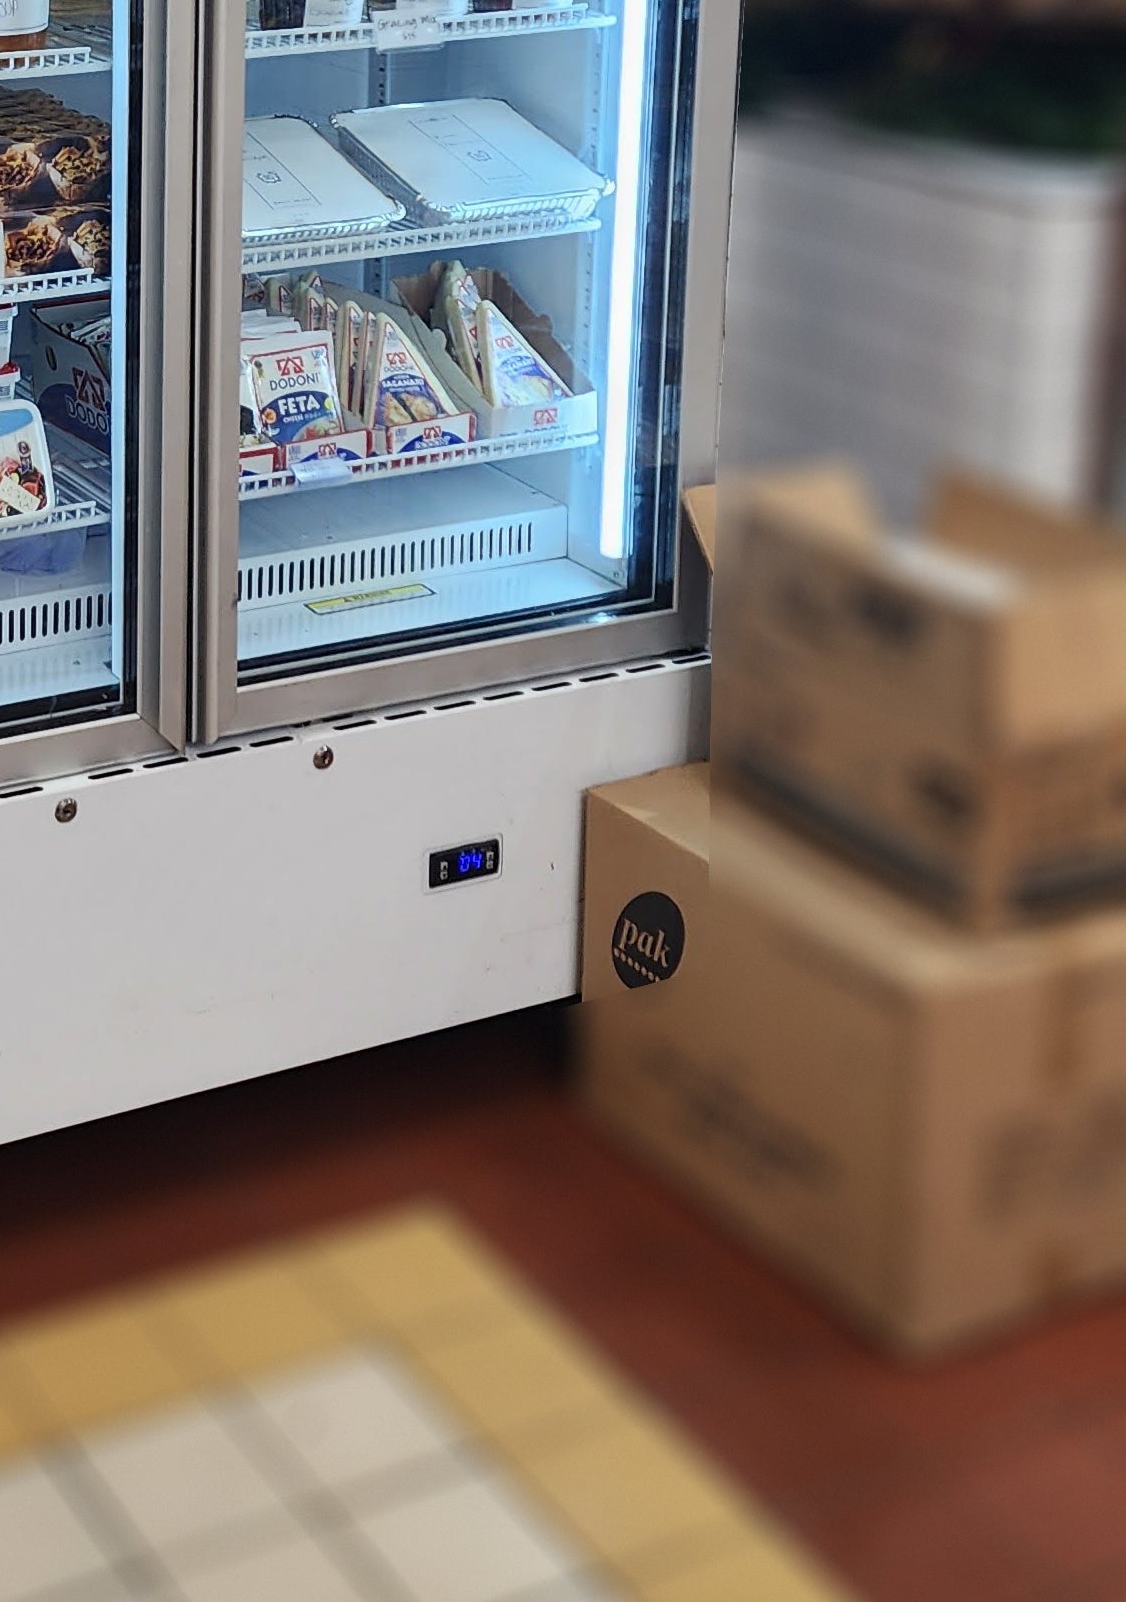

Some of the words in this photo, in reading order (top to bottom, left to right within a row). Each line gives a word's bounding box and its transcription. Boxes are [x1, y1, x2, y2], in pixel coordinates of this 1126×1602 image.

[269, 375, 319, 391] DODONI
[277, 394, 321, 416] FETA
[618, 918, 671, 968] pak
